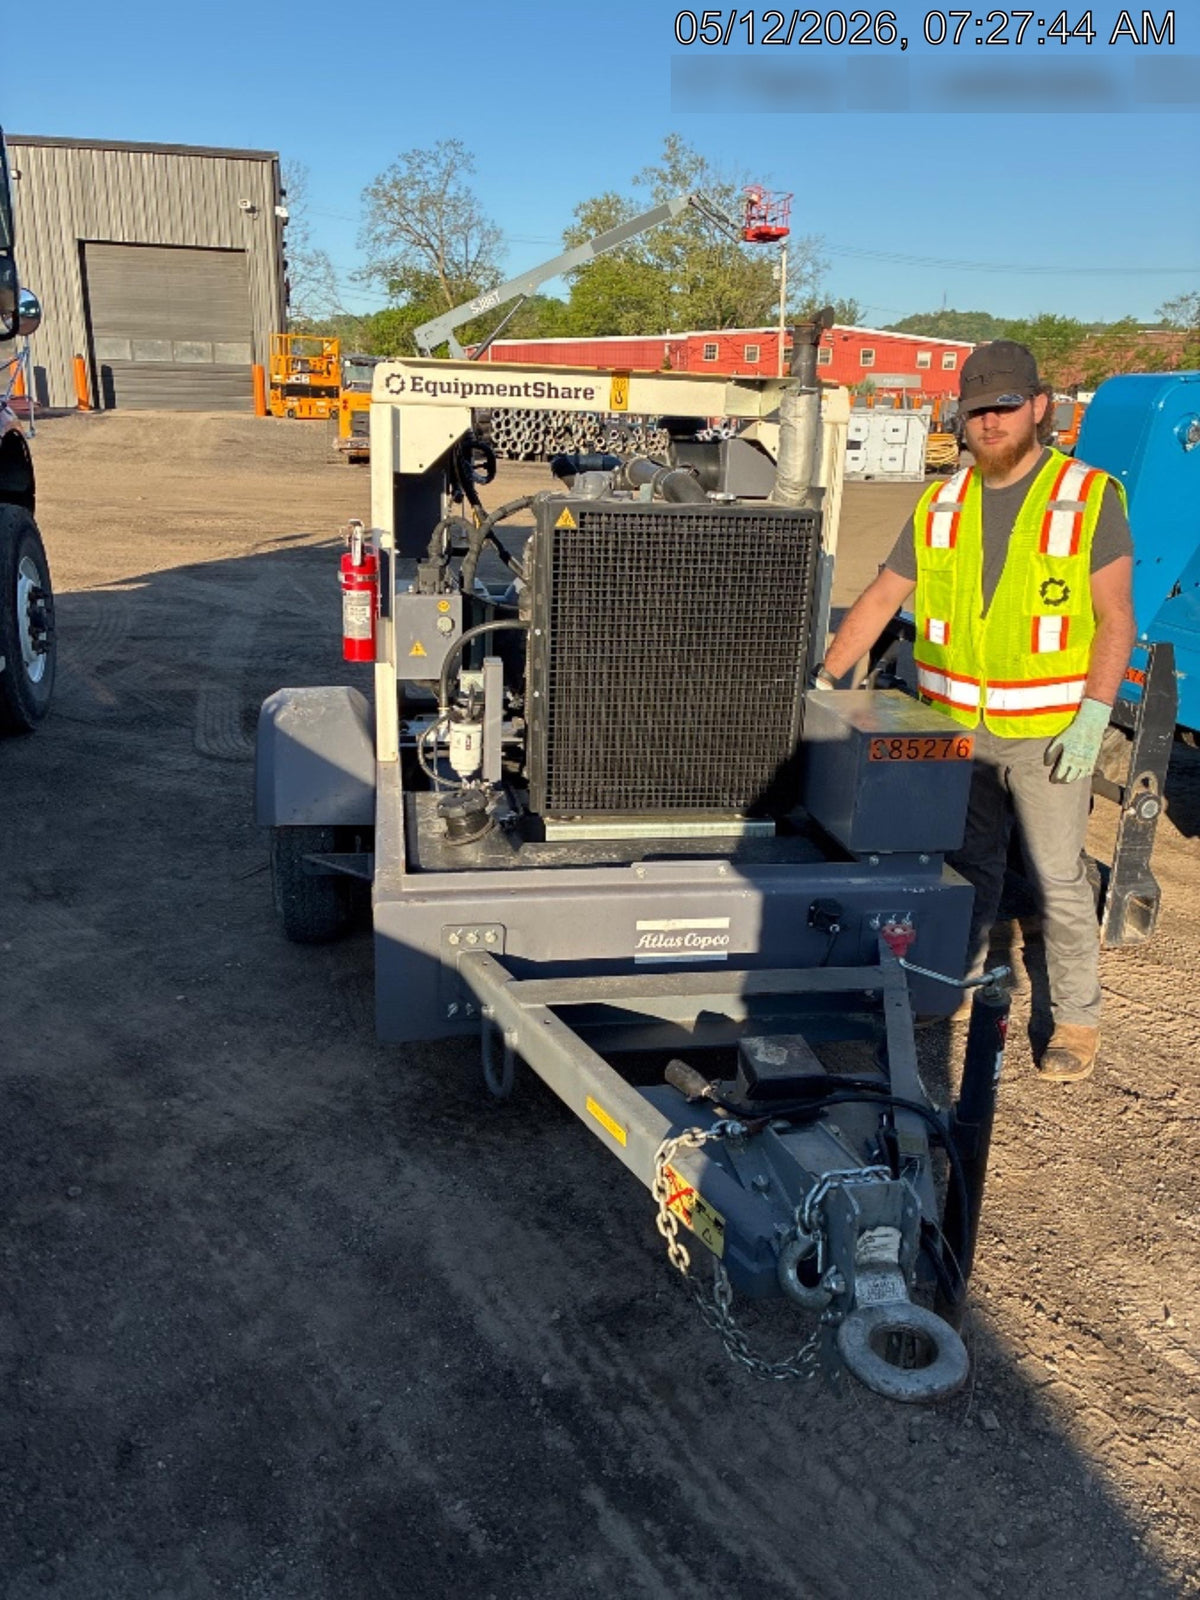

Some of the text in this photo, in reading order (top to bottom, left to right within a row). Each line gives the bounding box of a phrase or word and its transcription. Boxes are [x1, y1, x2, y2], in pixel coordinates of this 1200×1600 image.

[410, 375, 595, 400] EquipmentShare
[634, 932, 730, 949] Atlas Copco
